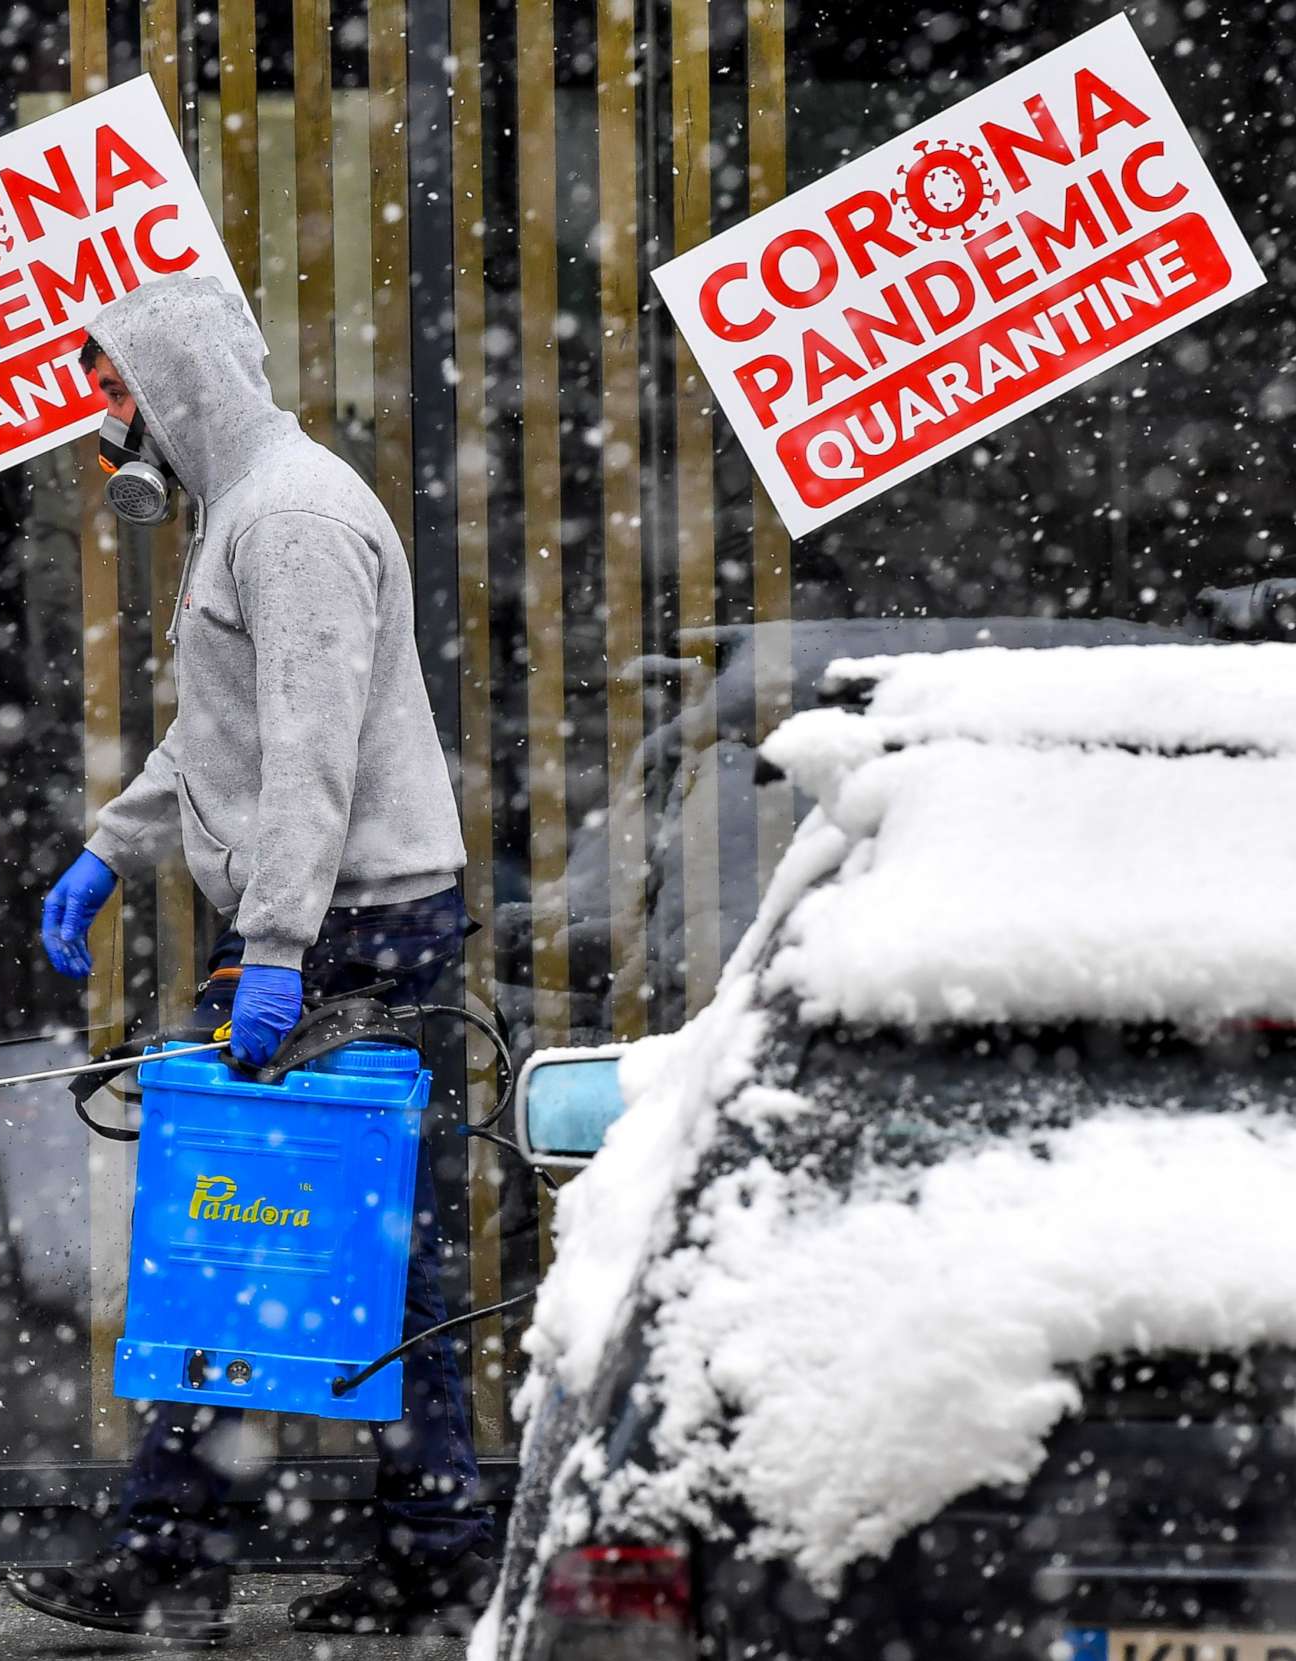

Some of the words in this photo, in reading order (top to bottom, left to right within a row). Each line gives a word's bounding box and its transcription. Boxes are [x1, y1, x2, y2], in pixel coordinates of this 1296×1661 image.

[699, 67, 1151, 343] CORONA
[733, 141, 1190, 430] PANDEMIC
[805, 238, 1197, 481] QUARANTINE
[188, 1174, 311, 1227] Pandora
[299, 1183, 313, 1192] 16L
